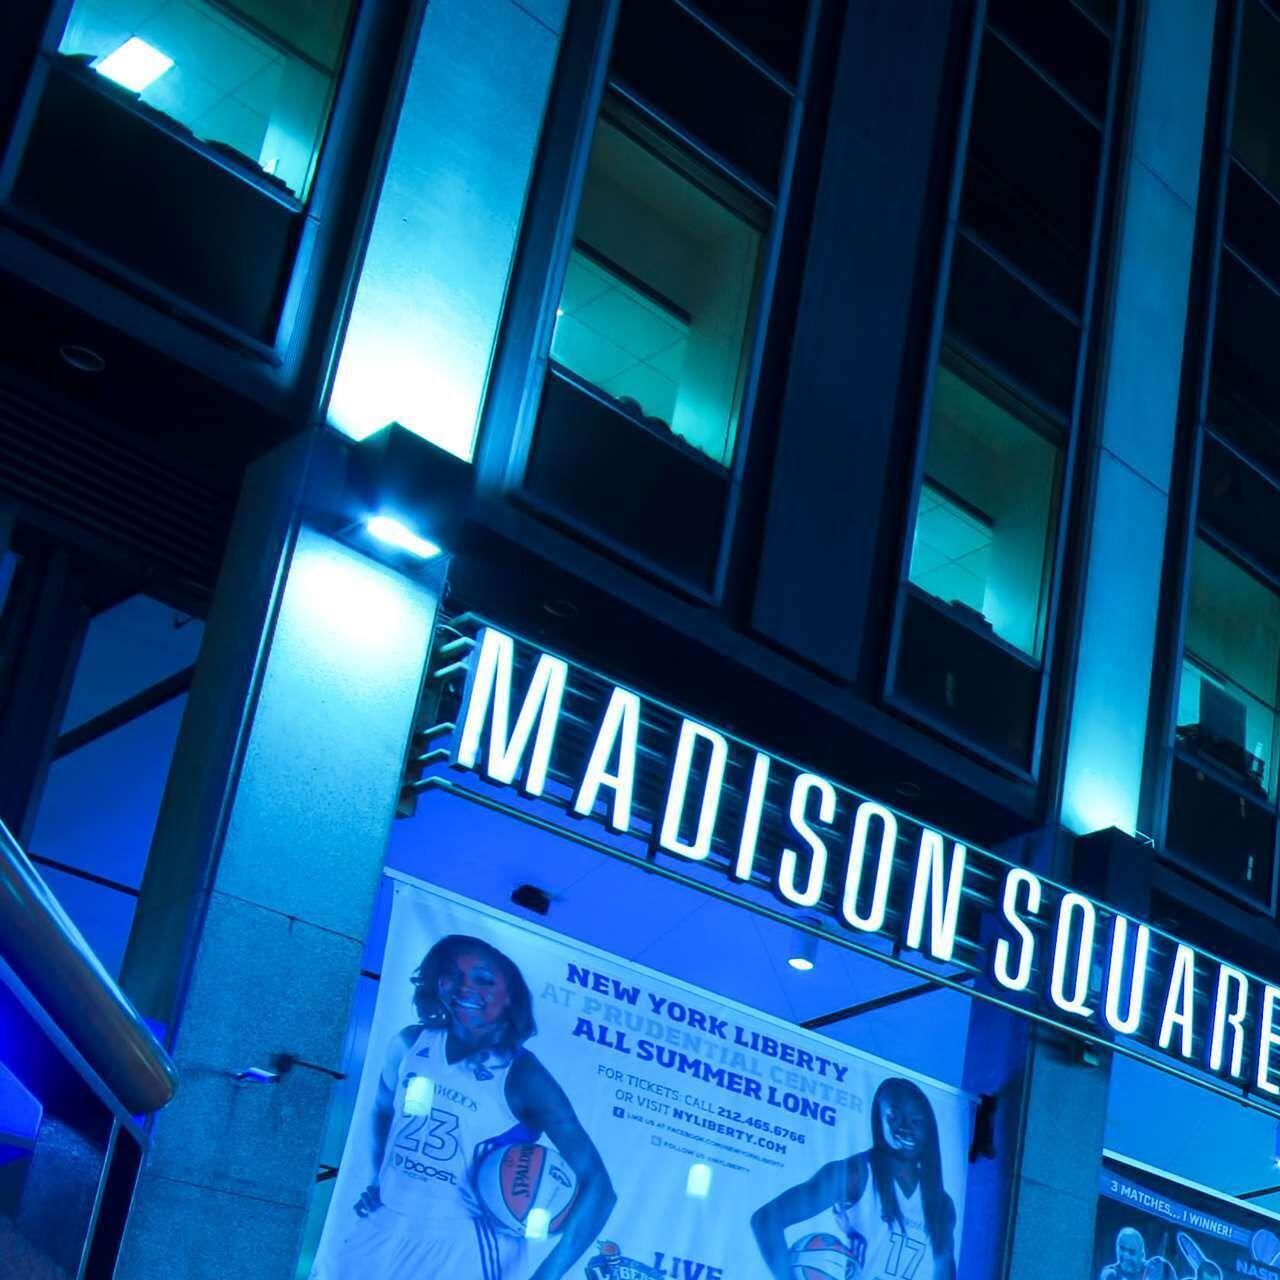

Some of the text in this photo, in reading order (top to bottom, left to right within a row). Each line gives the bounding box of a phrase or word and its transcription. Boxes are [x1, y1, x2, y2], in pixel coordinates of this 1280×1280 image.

[456, 627, 967, 961] MADISON
[540, 982, 864, 1114] AT PRUDENTIAL CENTER
[566, 963, 848, 1082] NEW YORK LIBERTY
[572, 1017, 837, 1127] ALL SUMMER LONG
[598, 1065, 624, 1082] FOR
[685, 1094, 715, 1114] CALL
[394, 1107, 459, 1162] 23
[615, 1089, 787, 1155] OR VISIT NYLIBERTY.COM
[405, 1158, 457, 1185] boost
[1110, 1180, 1118, 1193] 3
[1189, 1212, 1233, 1239] WINNER!
[885, 1232, 927, 1280] 17
